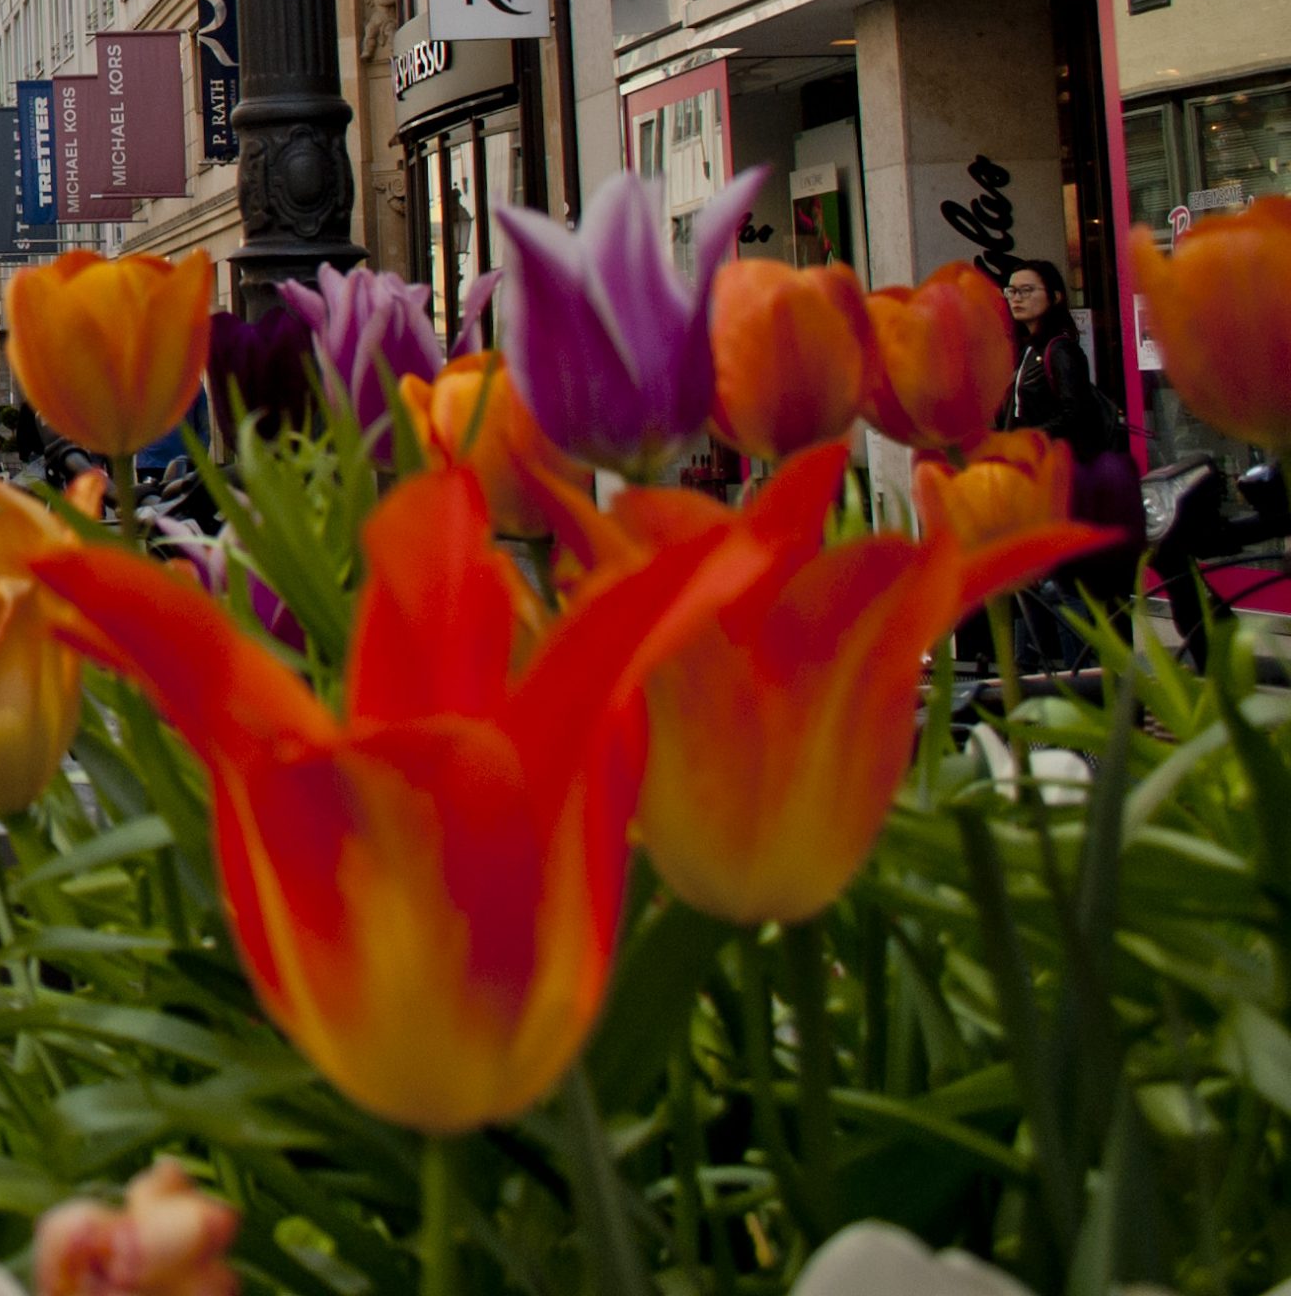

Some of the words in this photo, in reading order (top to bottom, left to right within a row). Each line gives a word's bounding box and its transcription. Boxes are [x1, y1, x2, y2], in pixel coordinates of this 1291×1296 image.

[107, 44, 124, 95] KORS
[62, 86, 77, 133] KORS
[210, 79, 226, 126] RATH
[34, 96, 52, 208] TRETTER
[65, 138, 80, 213] MICHAEL
[110, 102, 127, 186] MICHAEL
